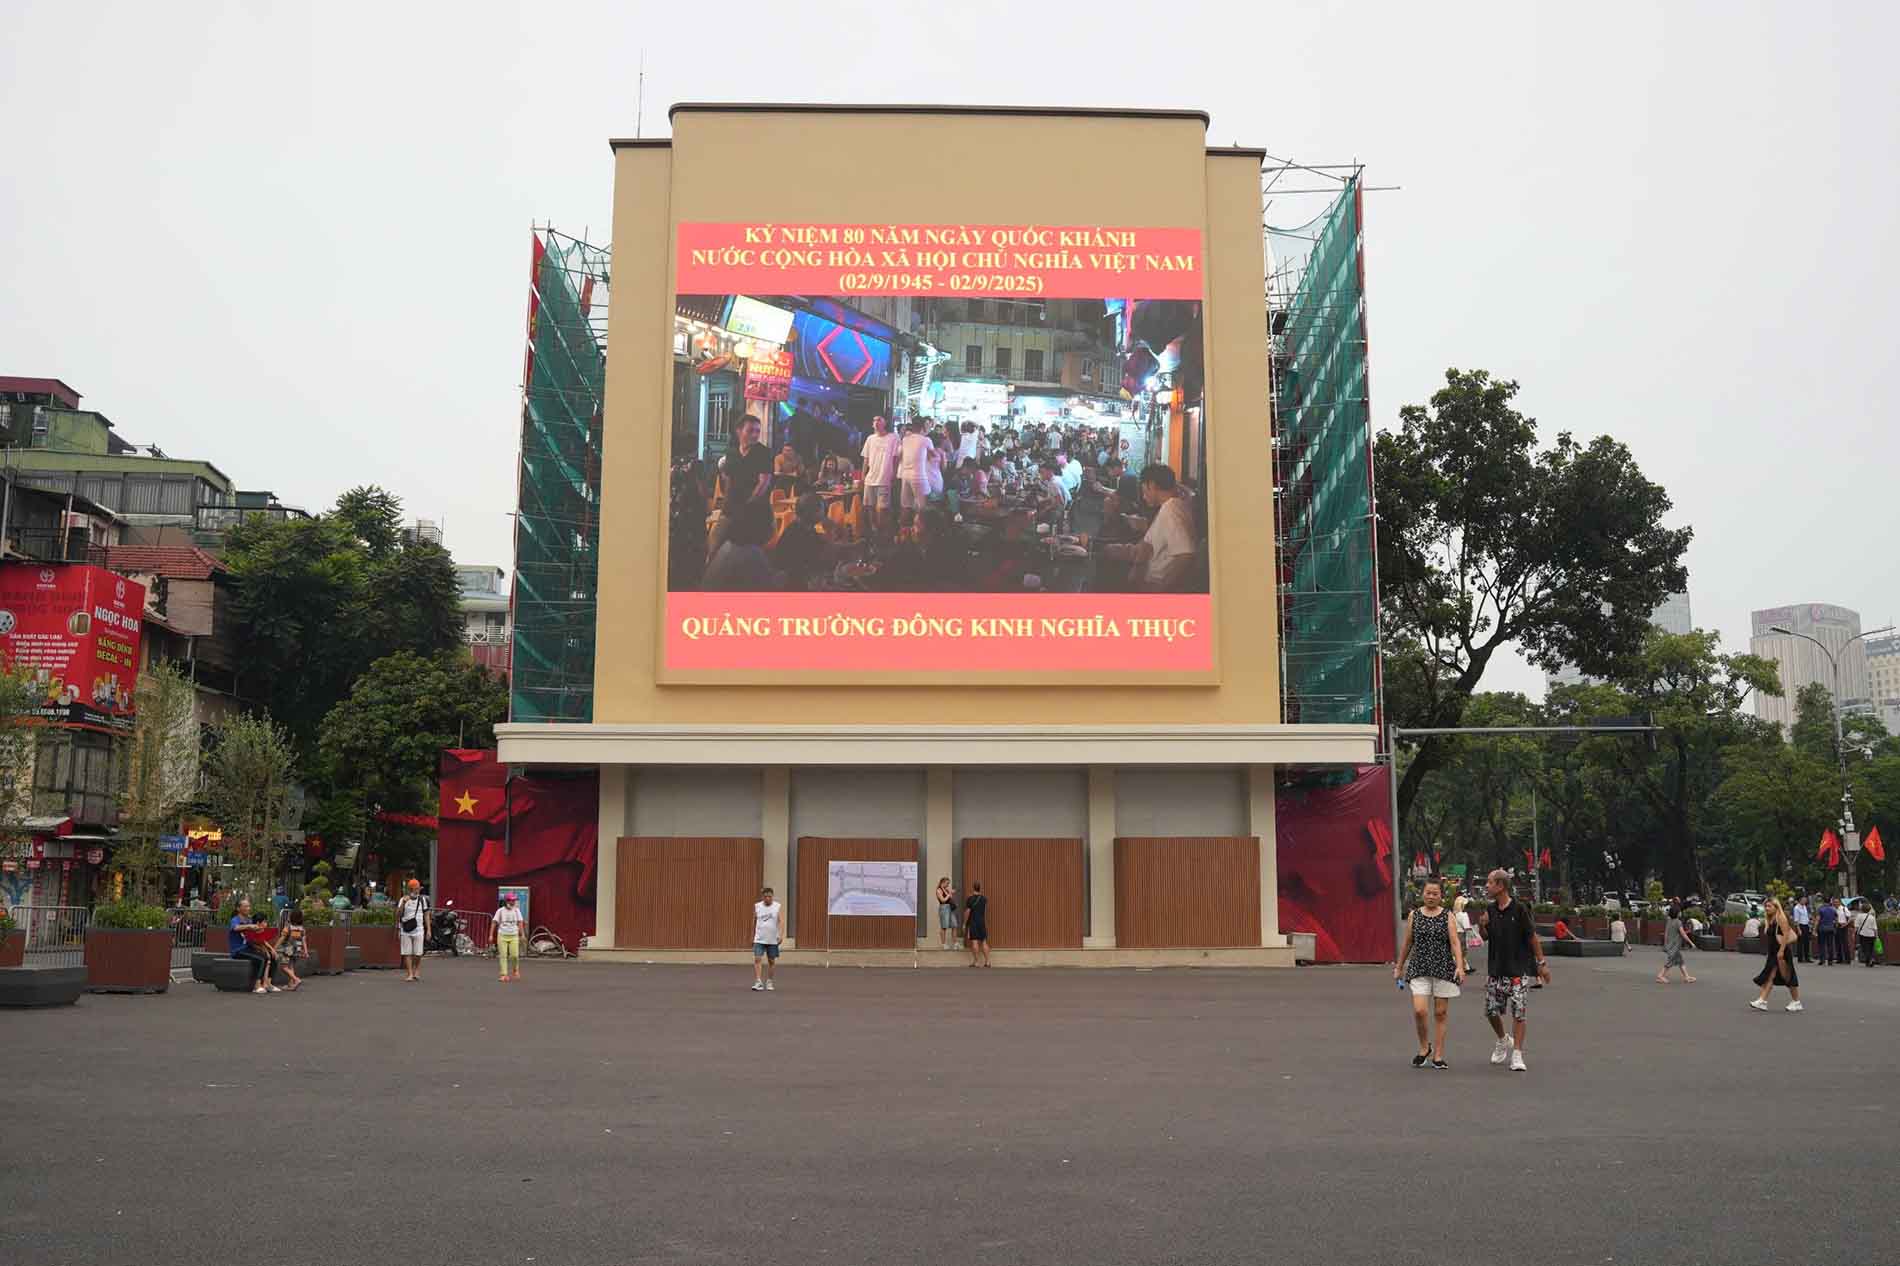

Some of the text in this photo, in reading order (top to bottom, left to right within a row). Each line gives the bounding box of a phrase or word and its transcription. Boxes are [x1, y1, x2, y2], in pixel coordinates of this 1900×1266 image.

[745, 226, 1136, 249] KỶ NIỆM 80 NĂM NGÀY QUỐC KHÁNH
[692, 246, 1193, 273] NƯỚC CỘNG HÒA XÃ HỘI CHỦ NGHĨA VIỆT NAM
[839, 273, 933, 292] (02/9/1945
[950, 274, 1043, 294] 02/9/2025)
[95, 606, 139, 632] NGỌC HOA
[682, 613, 1195, 643] QUẢNG TRƯỜNG ĐÔNG KINH NGHĨA THỤC
